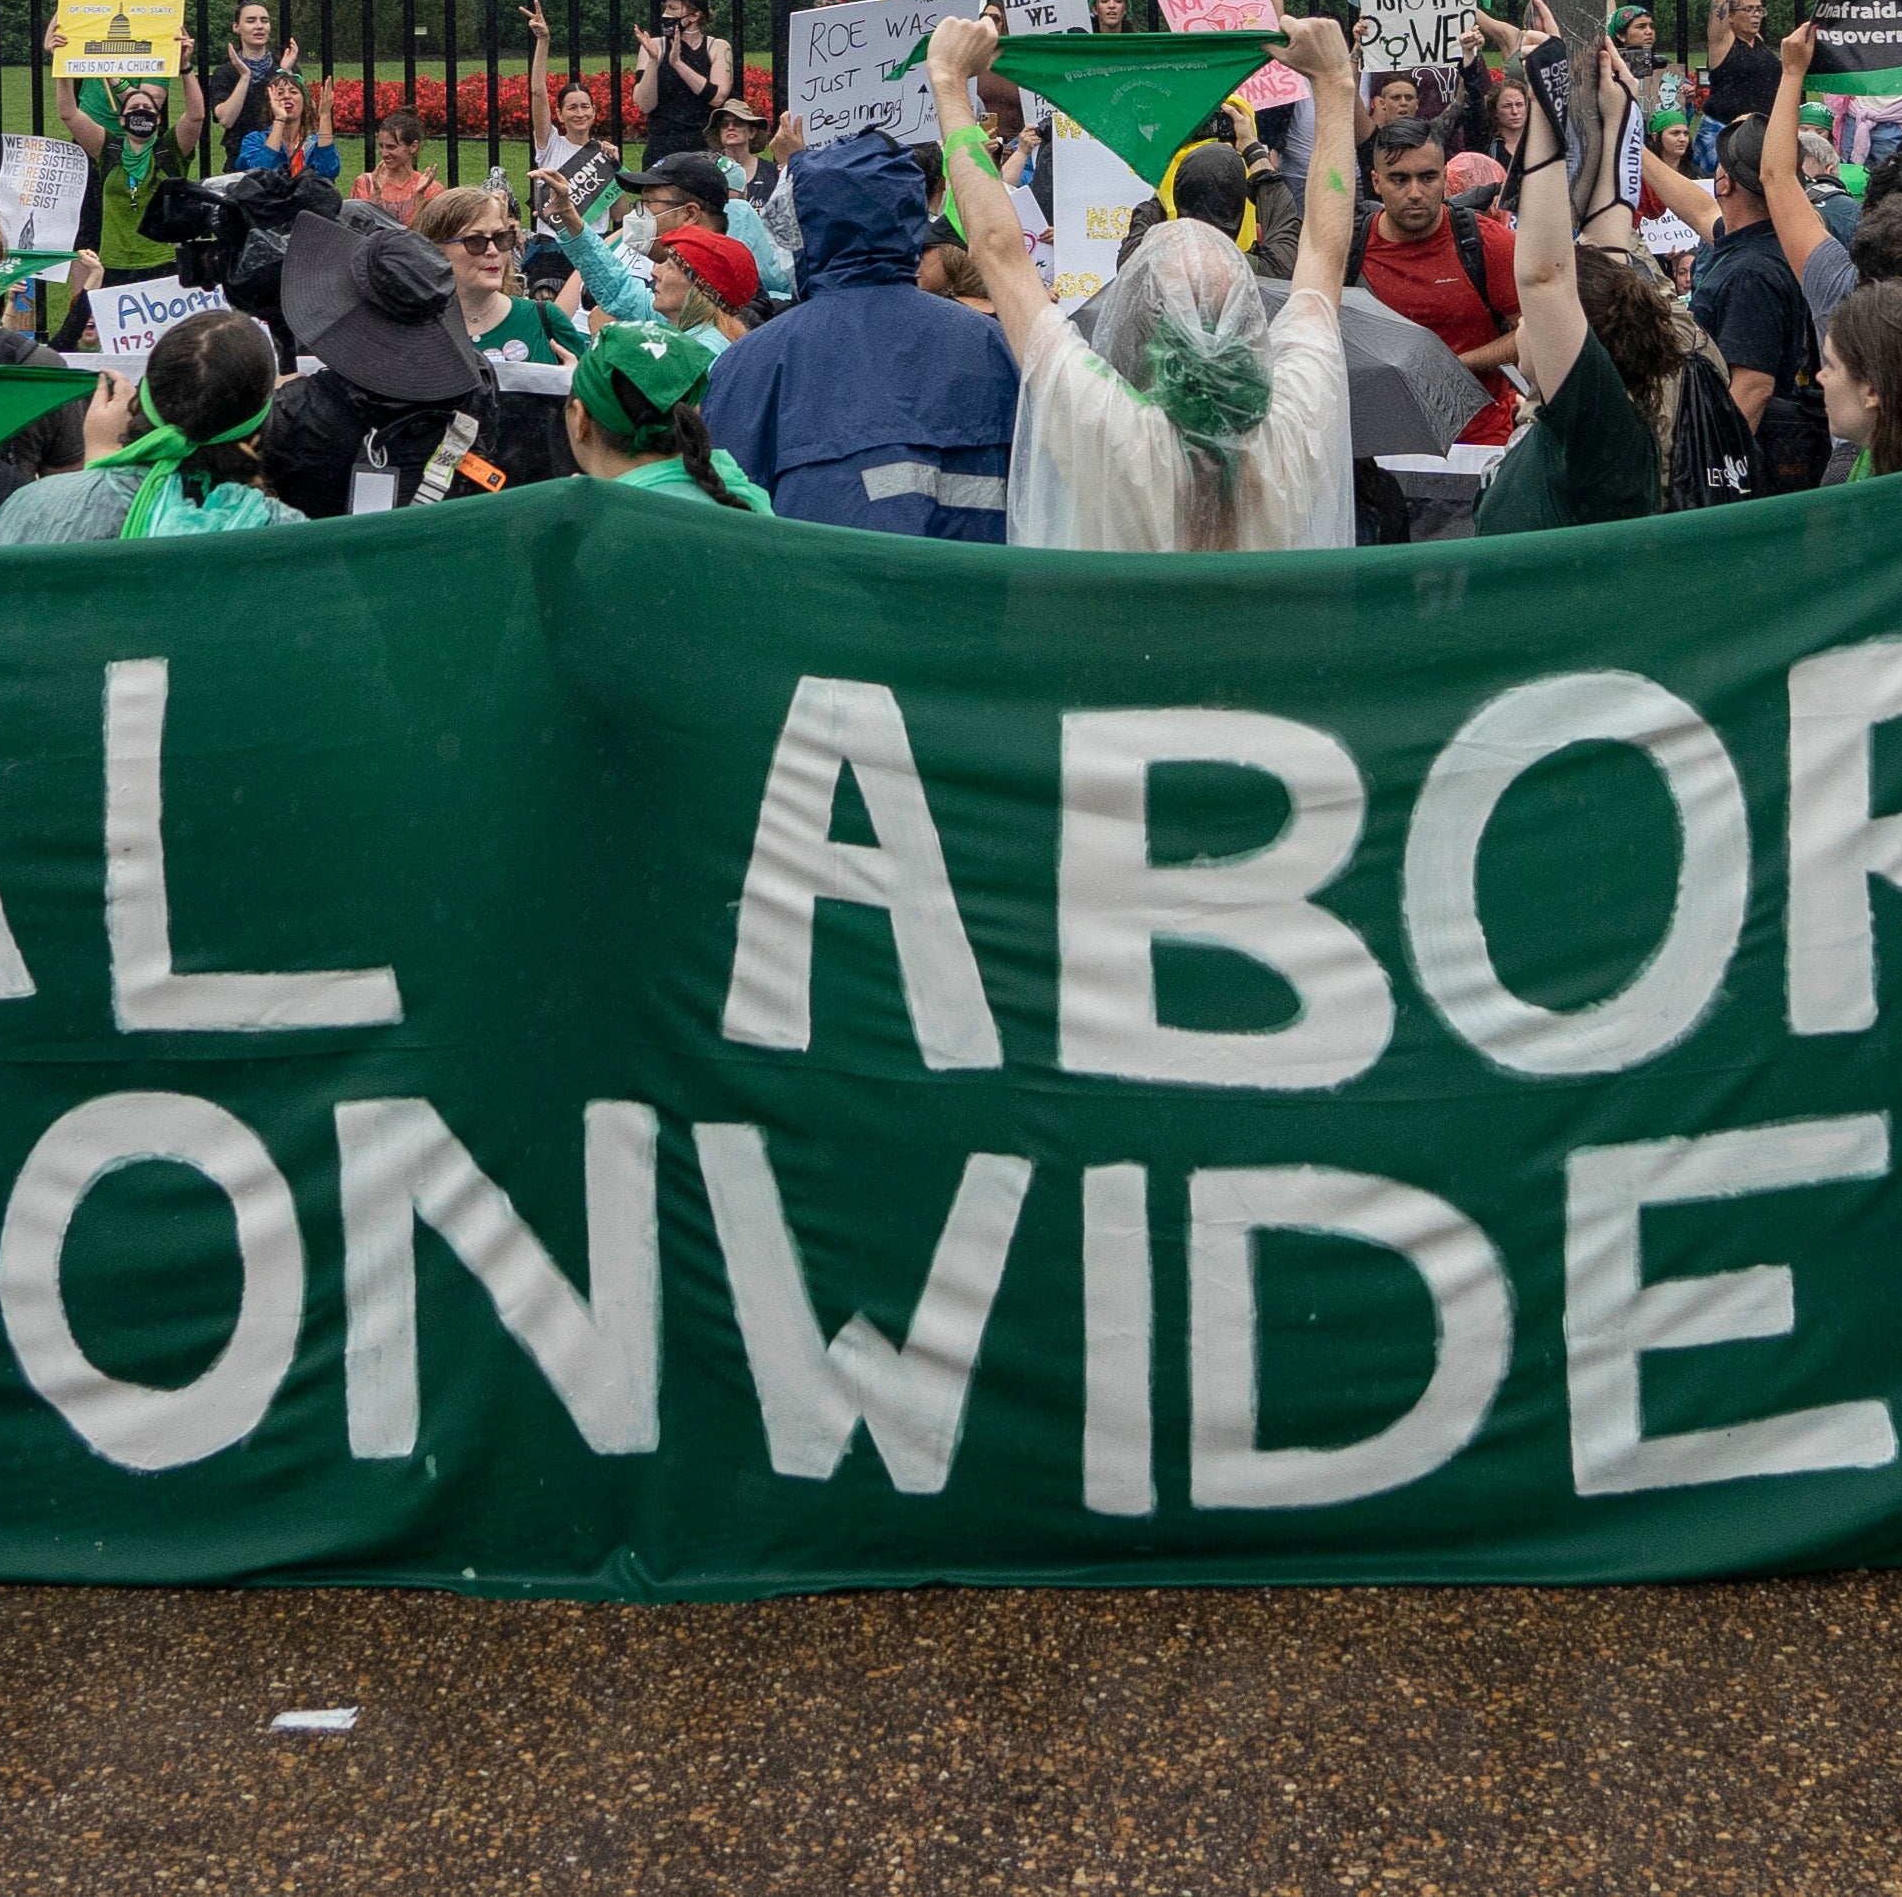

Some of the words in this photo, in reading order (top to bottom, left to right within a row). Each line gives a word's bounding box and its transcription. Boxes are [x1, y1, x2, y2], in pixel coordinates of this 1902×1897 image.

[1024, 4, 1058, 28] WE
[809, 20, 868, 67] ROE
[885, 13, 938, 39] WAS
[67, 61, 86, 73] THIS
[87, 61, 96, 72] IS
[97, 61, 115, 73] NOT
[117, 60, 124, 71] A
[801, 67, 861, 102] JUST
[19, 193, 59, 210] RESIST
[569, 172, 606, 206] BACK
[113, 330, 156, 355] 1973
